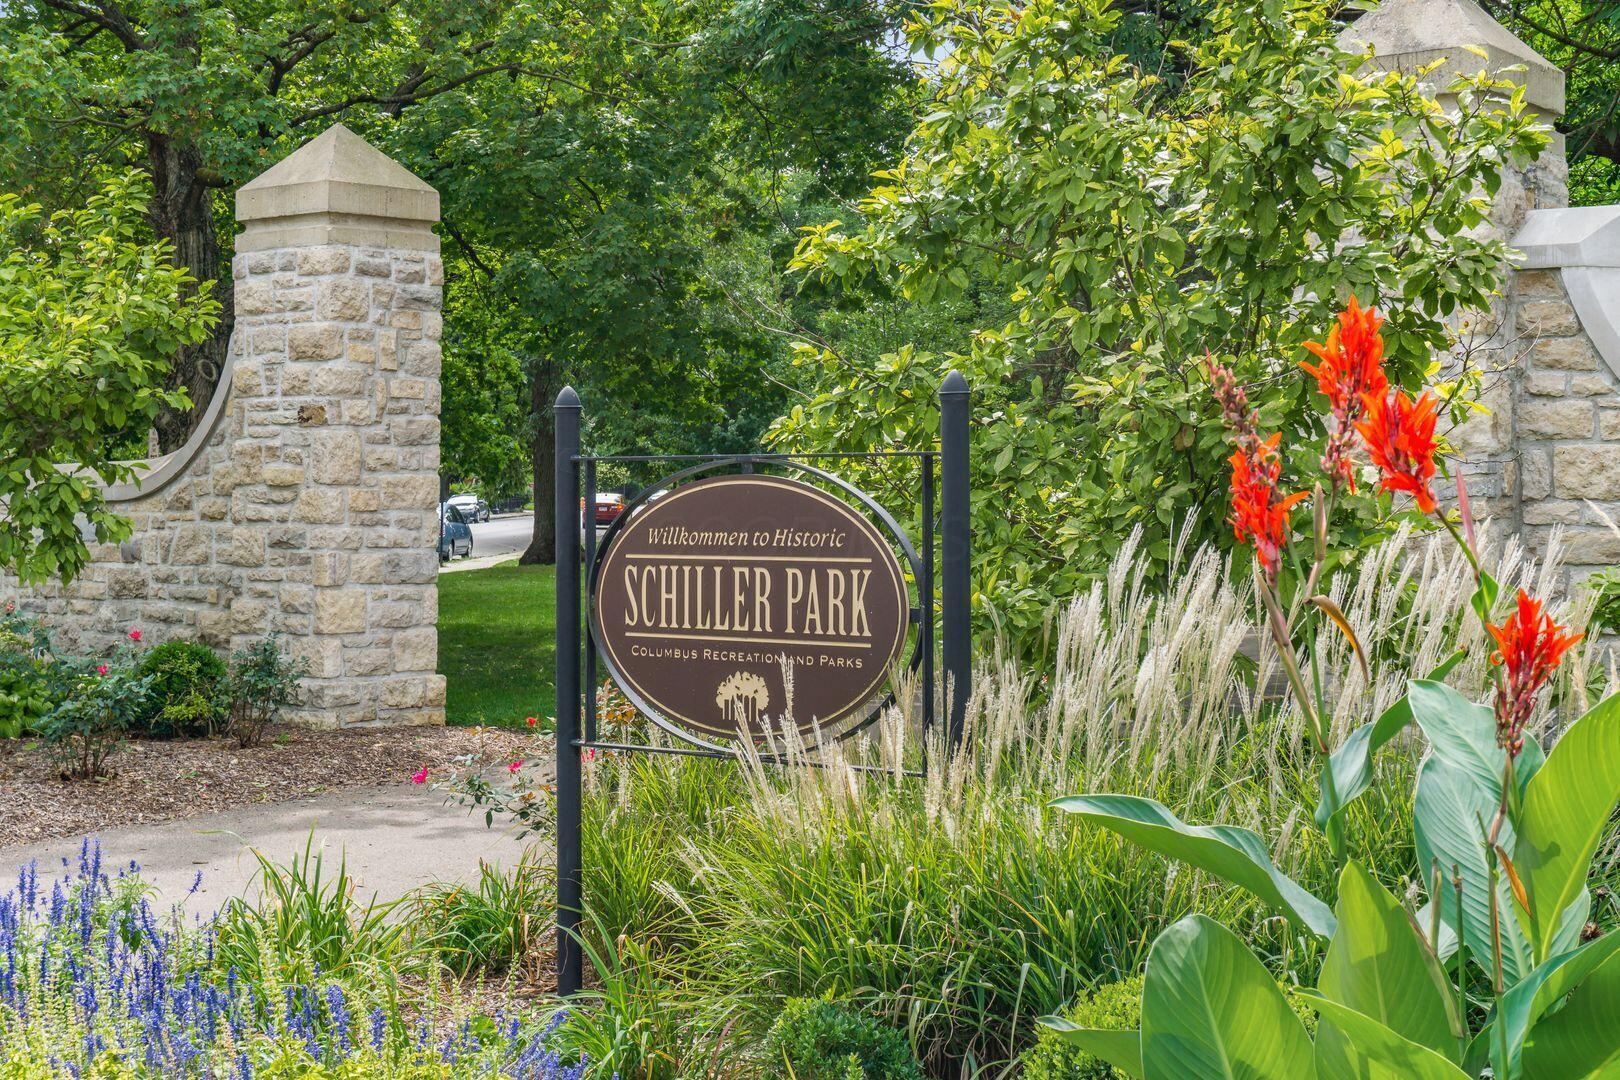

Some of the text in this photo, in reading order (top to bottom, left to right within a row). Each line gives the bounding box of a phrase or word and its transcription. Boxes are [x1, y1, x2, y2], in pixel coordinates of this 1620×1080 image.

[648, 527, 749, 548] Willkommen
[752, 531, 769, 548] to
[772, 528, 846, 549] Historic
[624, 564, 872, 637] SCHILLER PARK
